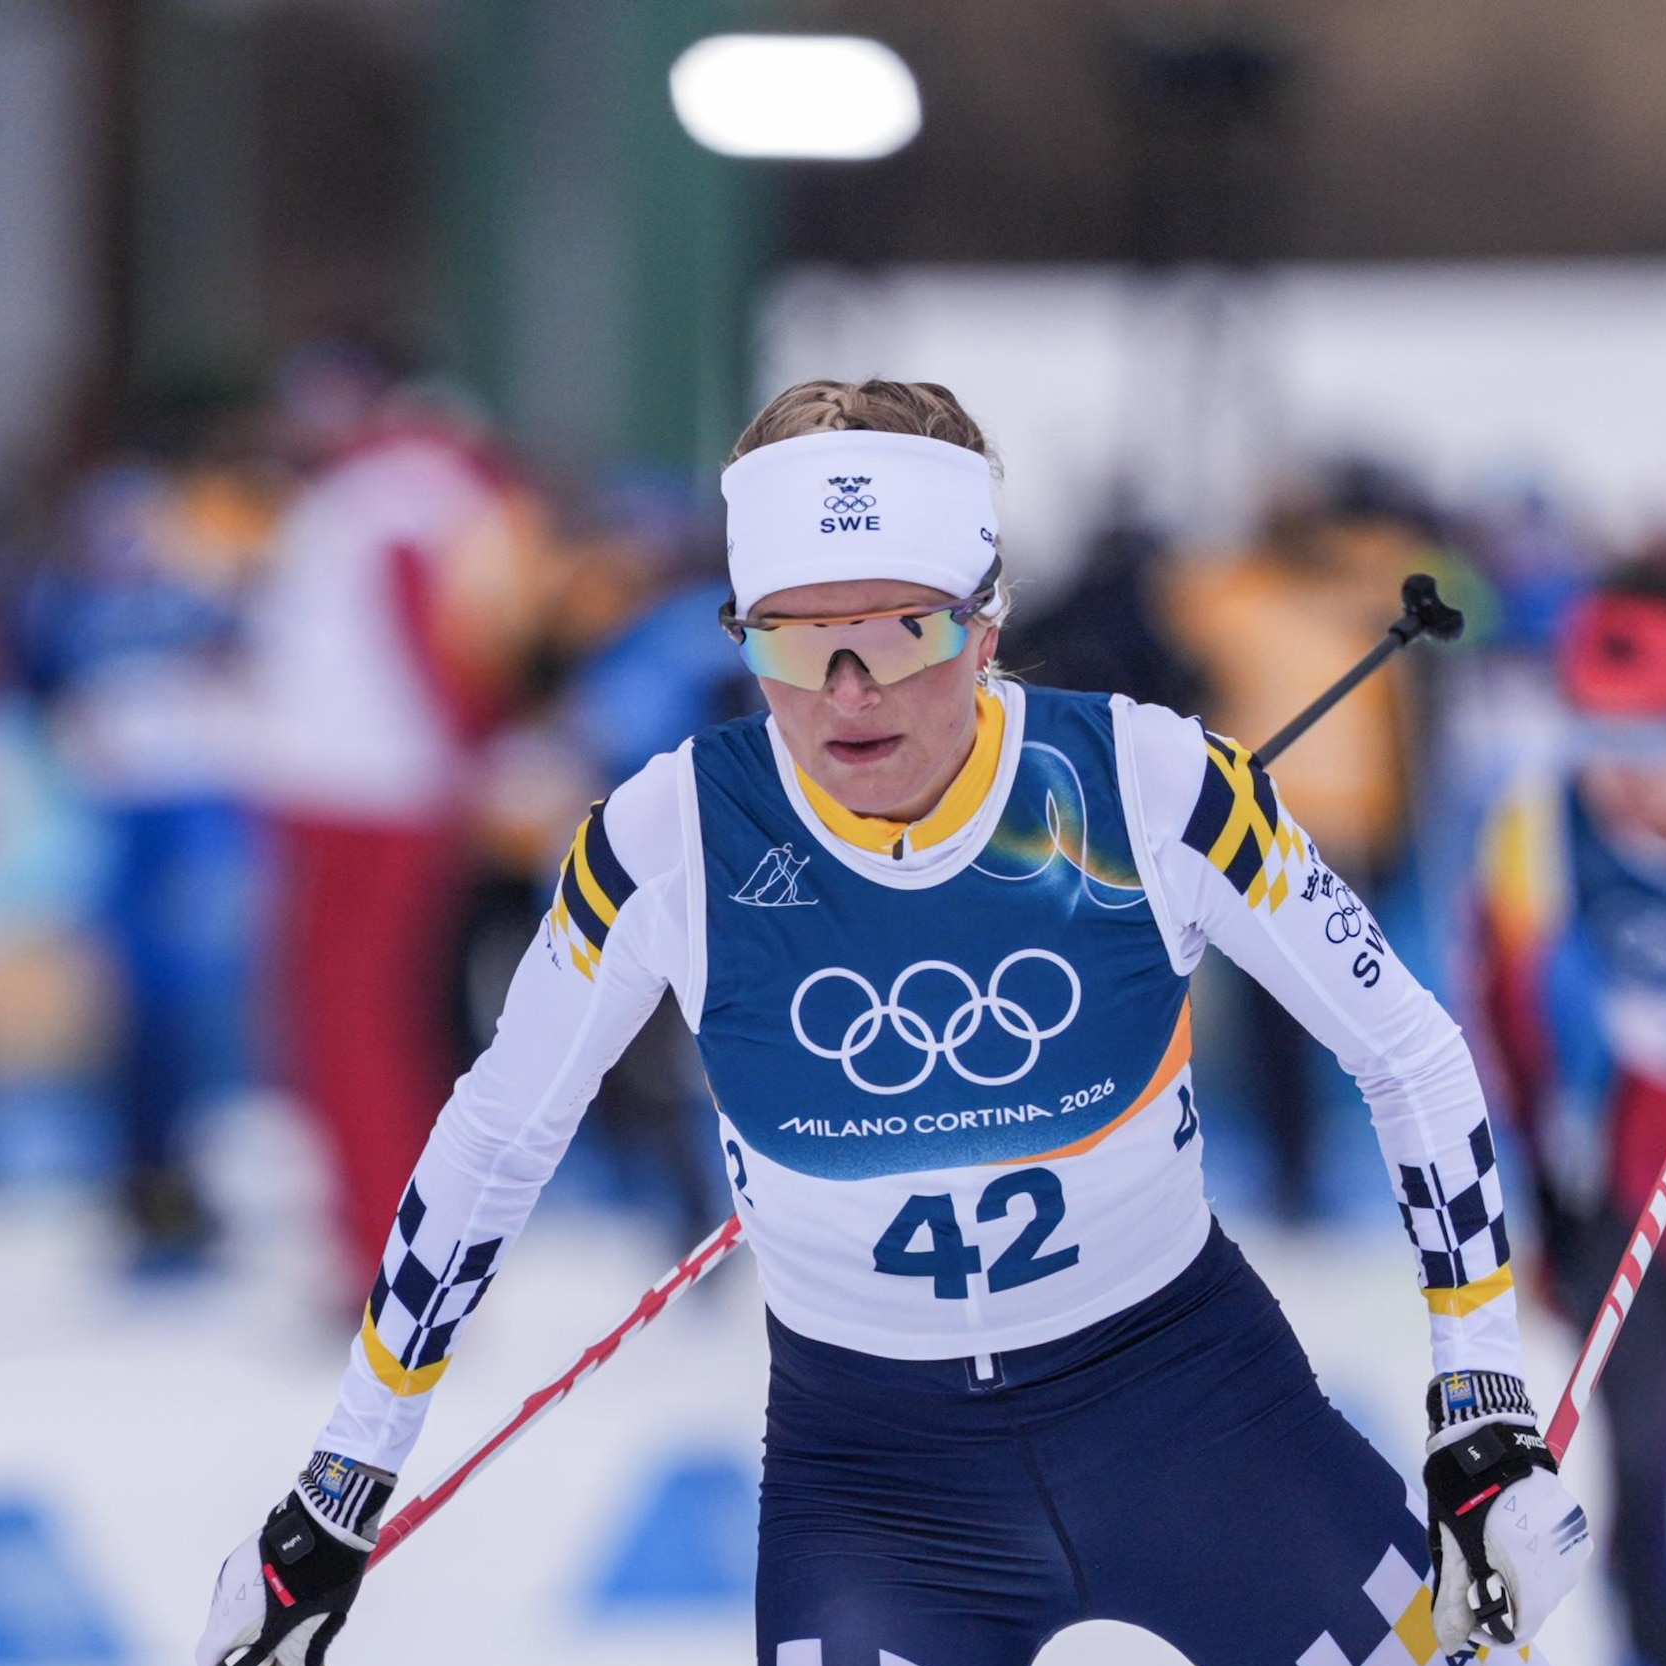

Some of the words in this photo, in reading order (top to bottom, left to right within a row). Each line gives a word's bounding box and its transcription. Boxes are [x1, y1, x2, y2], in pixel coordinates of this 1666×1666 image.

[820, 515, 881, 533] SWE
[779, 1116, 907, 1137] MILANO
[914, 1103, 1053, 1133] CORTINA
[1060, 1078, 1115, 1114] 2026
[872, 1167, 1080, 1300] 42
